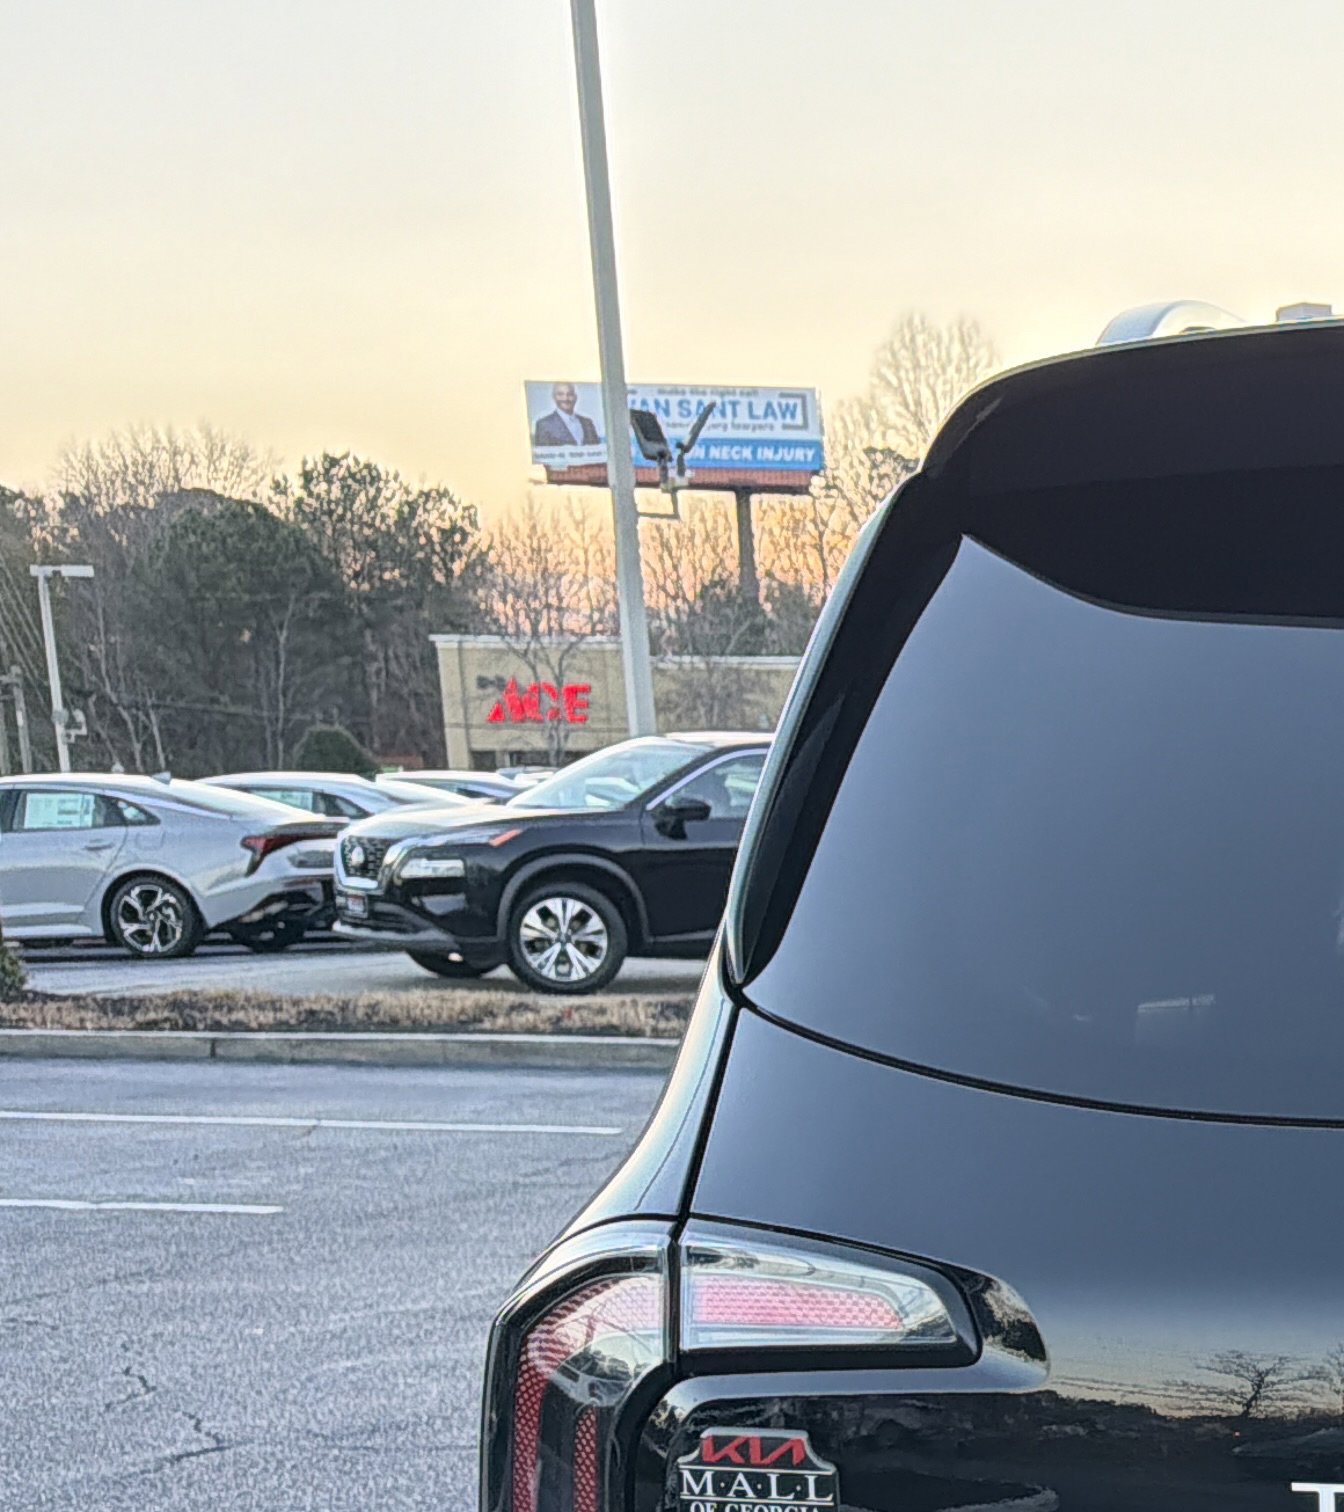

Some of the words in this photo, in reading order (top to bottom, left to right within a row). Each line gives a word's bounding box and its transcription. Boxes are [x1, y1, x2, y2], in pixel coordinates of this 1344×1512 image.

[748, 401, 799, 421] LAW
[709, 444, 752, 460] NECK
[757, 445, 816, 462] INJURY
[487, 676, 592, 724] ACE
[701, 1434, 806, 1466] KIA
